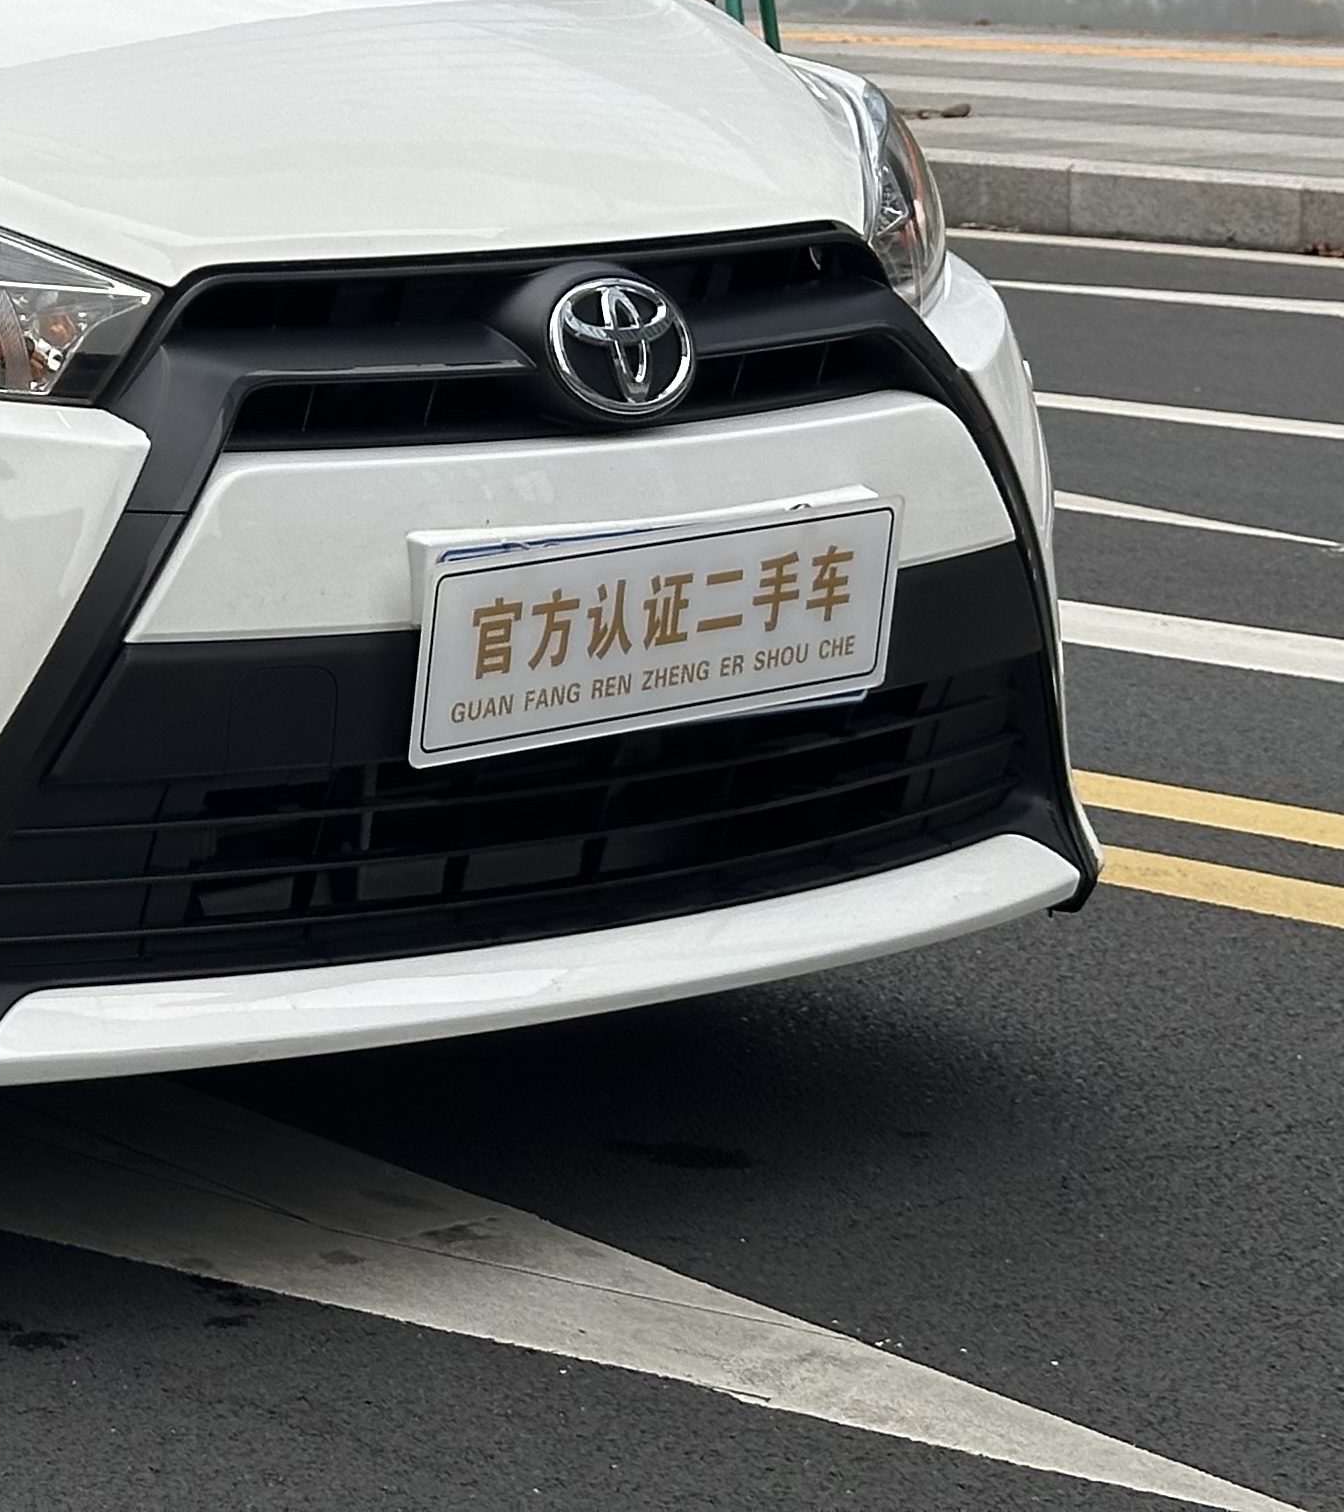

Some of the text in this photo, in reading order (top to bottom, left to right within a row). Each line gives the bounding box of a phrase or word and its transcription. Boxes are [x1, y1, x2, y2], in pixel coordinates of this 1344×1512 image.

[472, 544, 855, 680] 官方认证二手车
[450, 635, 856, 723] GUAN FANG REN ZHENG ER SHOU CHE
